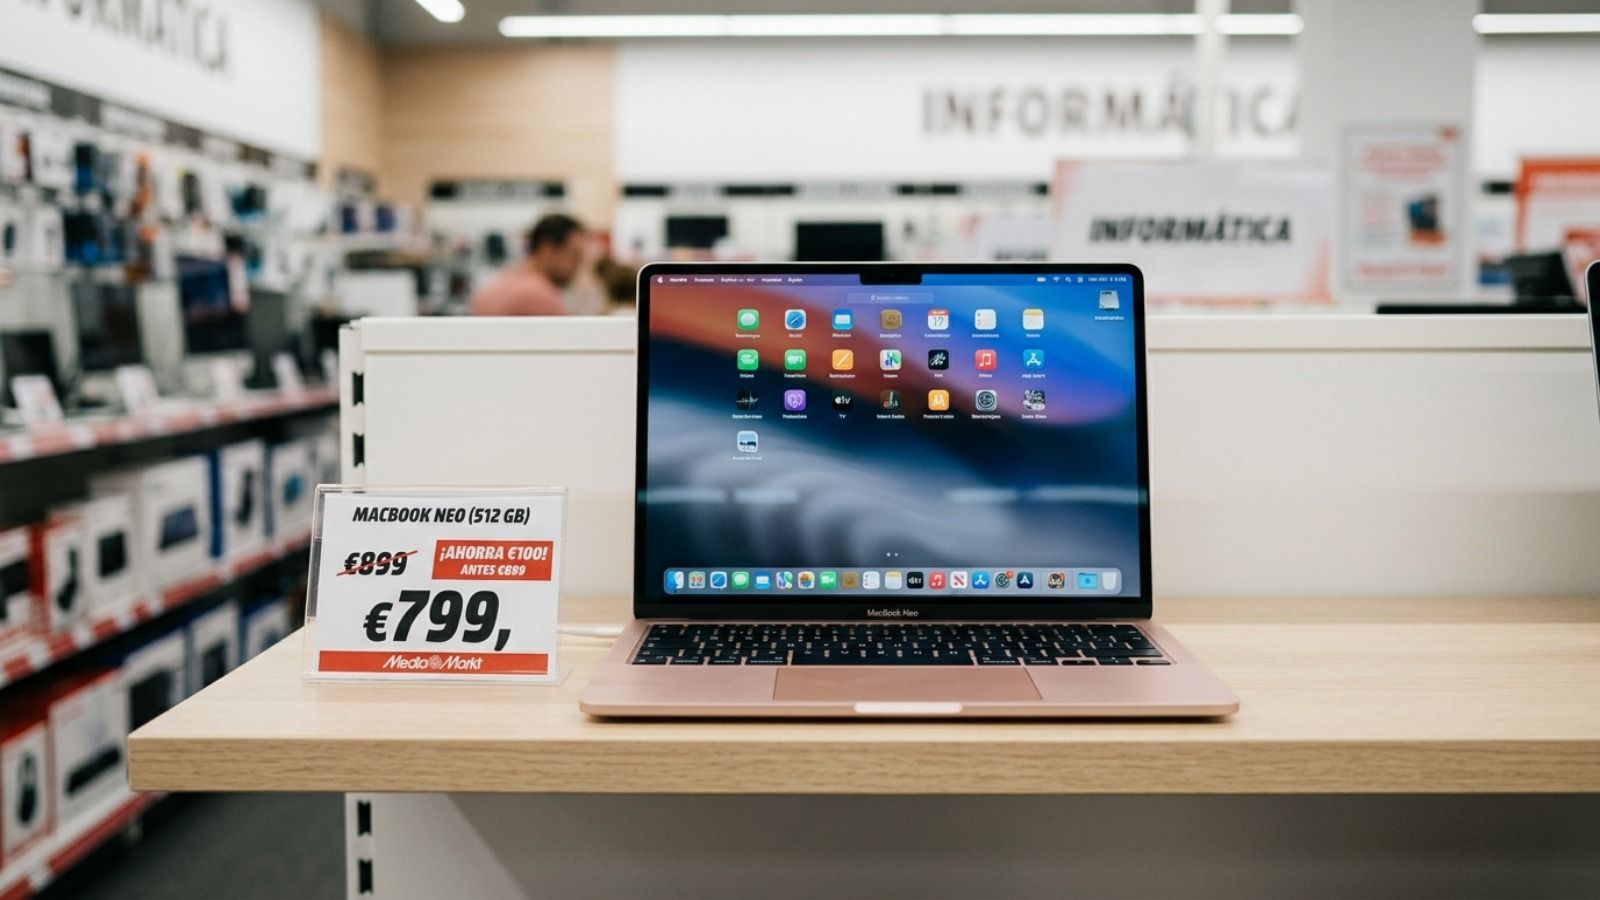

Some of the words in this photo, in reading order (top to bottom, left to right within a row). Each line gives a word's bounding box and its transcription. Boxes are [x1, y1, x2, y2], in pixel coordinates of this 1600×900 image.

[1088, 207, 1292, 243] INFORMÁTICA
[352, 507, 432, 522] MACBOOK
[434, 508, 466, 523] NEO
[469, 507, 501, 525] (512
[503, 507, 531, 525] GB)
[344, 551, 408, 576] €899
[439, 545, 505, 562] ¡AHORRA
[508, 546, 549, 561] €100!
[460, 564, 496, 576] ANTES
[363, 590, 512, 652] €799,
